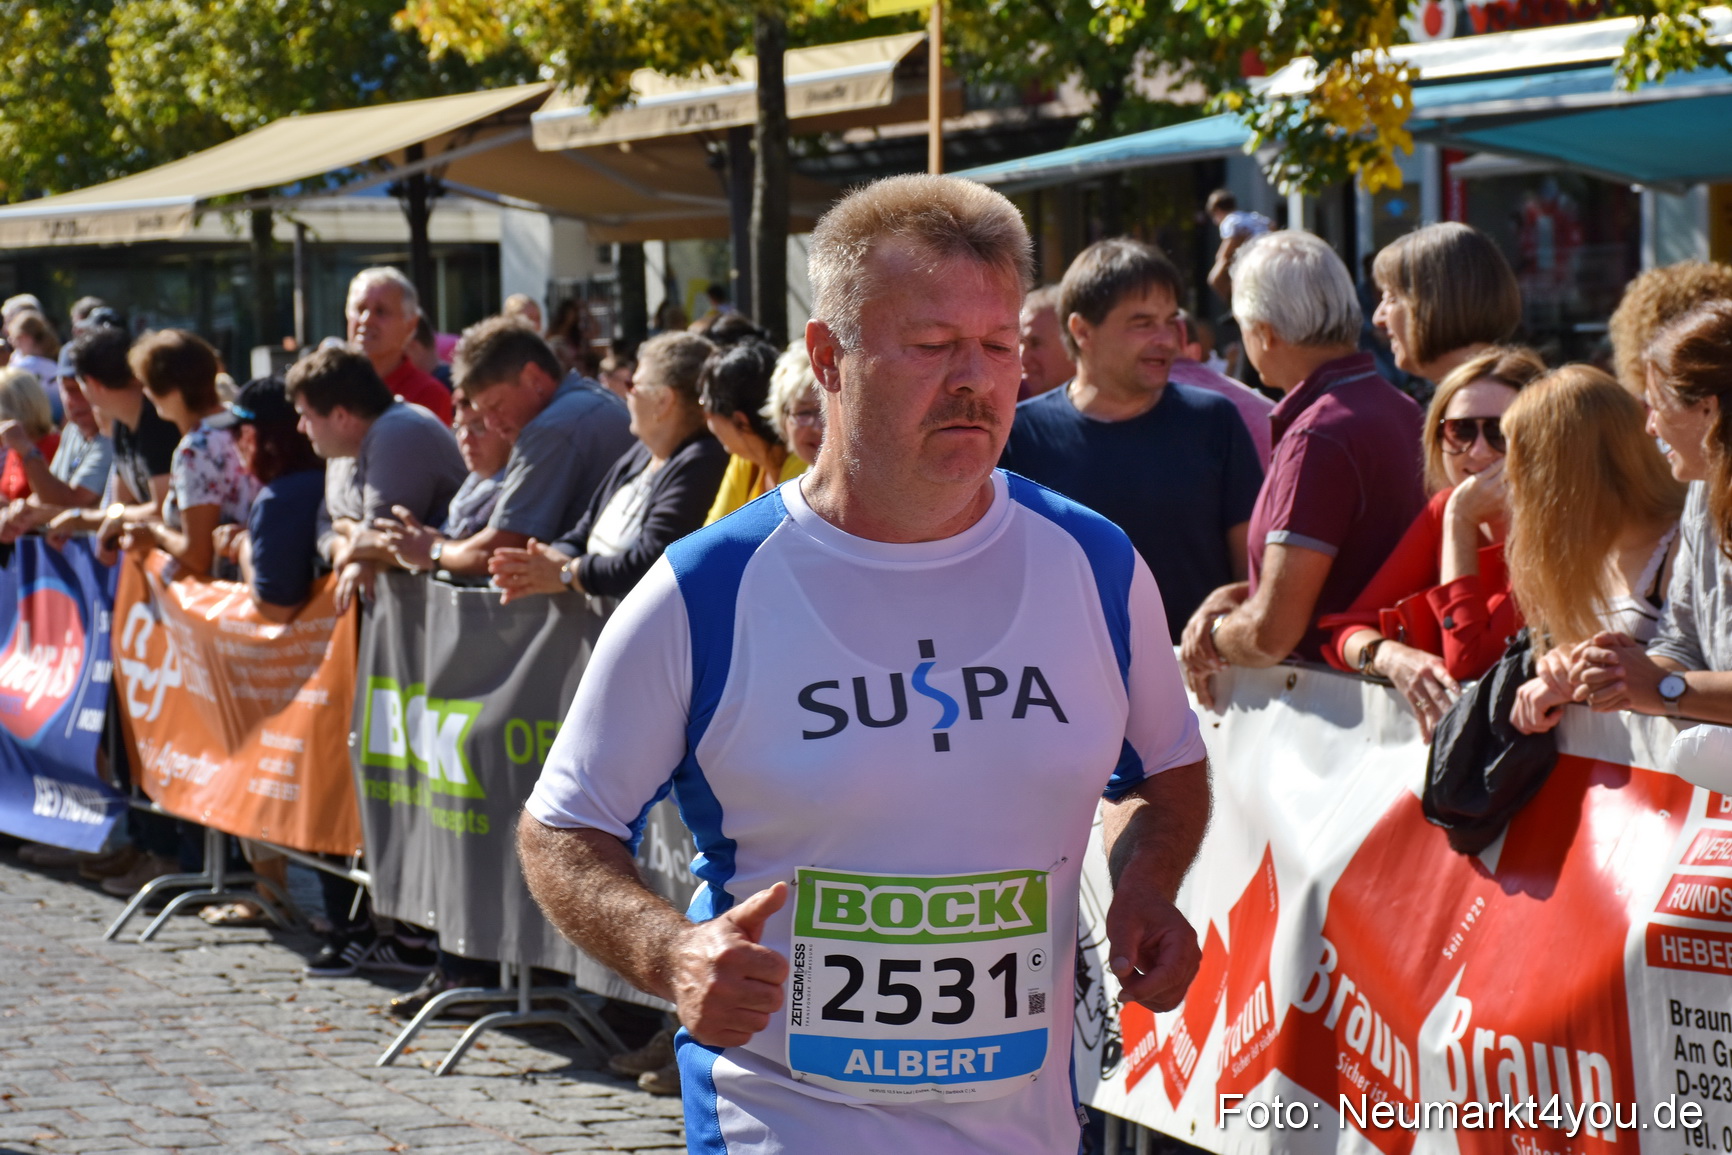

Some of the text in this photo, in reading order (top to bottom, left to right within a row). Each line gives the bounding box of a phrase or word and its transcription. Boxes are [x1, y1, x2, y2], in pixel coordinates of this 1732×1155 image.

[798, 639, 1069, 752] SUSPA
[504, 718, 563, 765] OF
[1697, 837, 1732, 860] VER
[817, 881, 1027, 932] BOCK
[1442, 896, 1486, 961] Seit 1929
[1031, 953, 1042, 967] C
[821, 952, 1018, 1026] 2531
[1297, 933, 1413, 1101] Braun
[1669, 999, 1732, 1033] Braun
[843, 1045, 1001, 1078] ALBERT
[1437, 995, 1617, 1143] Braun
[1674, 1034, 1706, 1064] Am
[1335, 1051, 1371, 1093] Sicher
[1676, 1069, 1732, 1103] D-923
